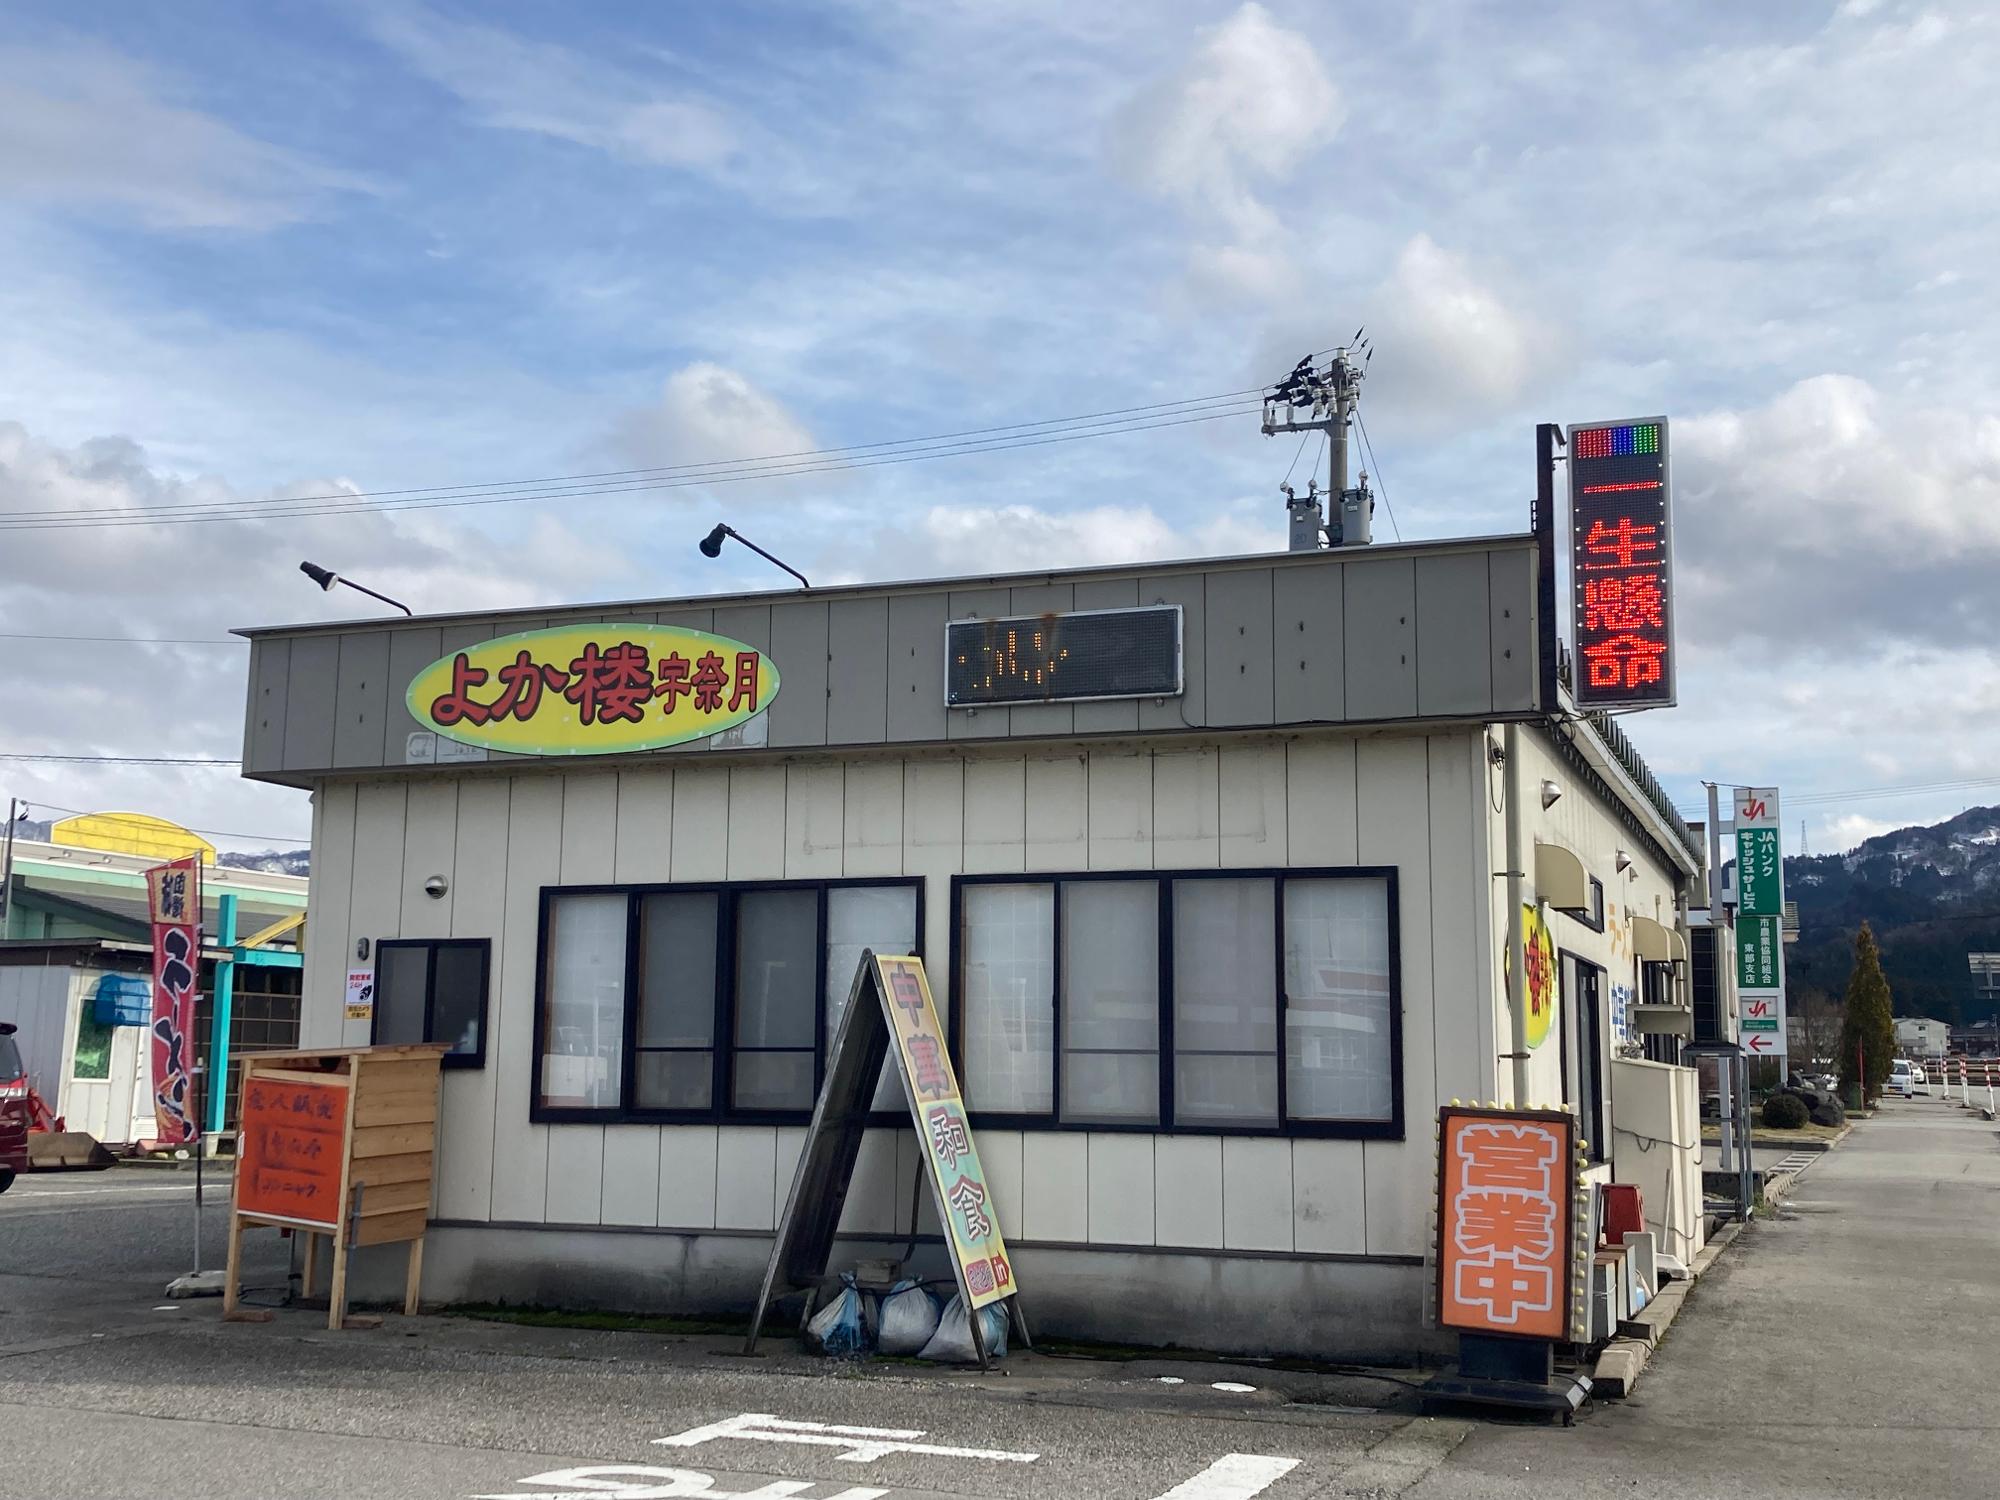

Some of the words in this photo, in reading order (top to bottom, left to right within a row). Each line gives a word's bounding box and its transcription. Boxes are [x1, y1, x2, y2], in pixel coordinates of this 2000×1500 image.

[1583, 481, 1667, 688] 一生懸命
[1742, 798, 1766, 821] JA
[1740, 832, 1756, 910] キャッシュサービス
[1757, 831, 1776, 877] JAバンク
[1744, 943, 1756, 984] 東部支店
[890, 962, 950, 1100] 中華
[1748, 1000, 1767, 1018] JA
[928, 1107, 992, 1242] 和食
[1453, 1122, 1558, 1325] 営業中
